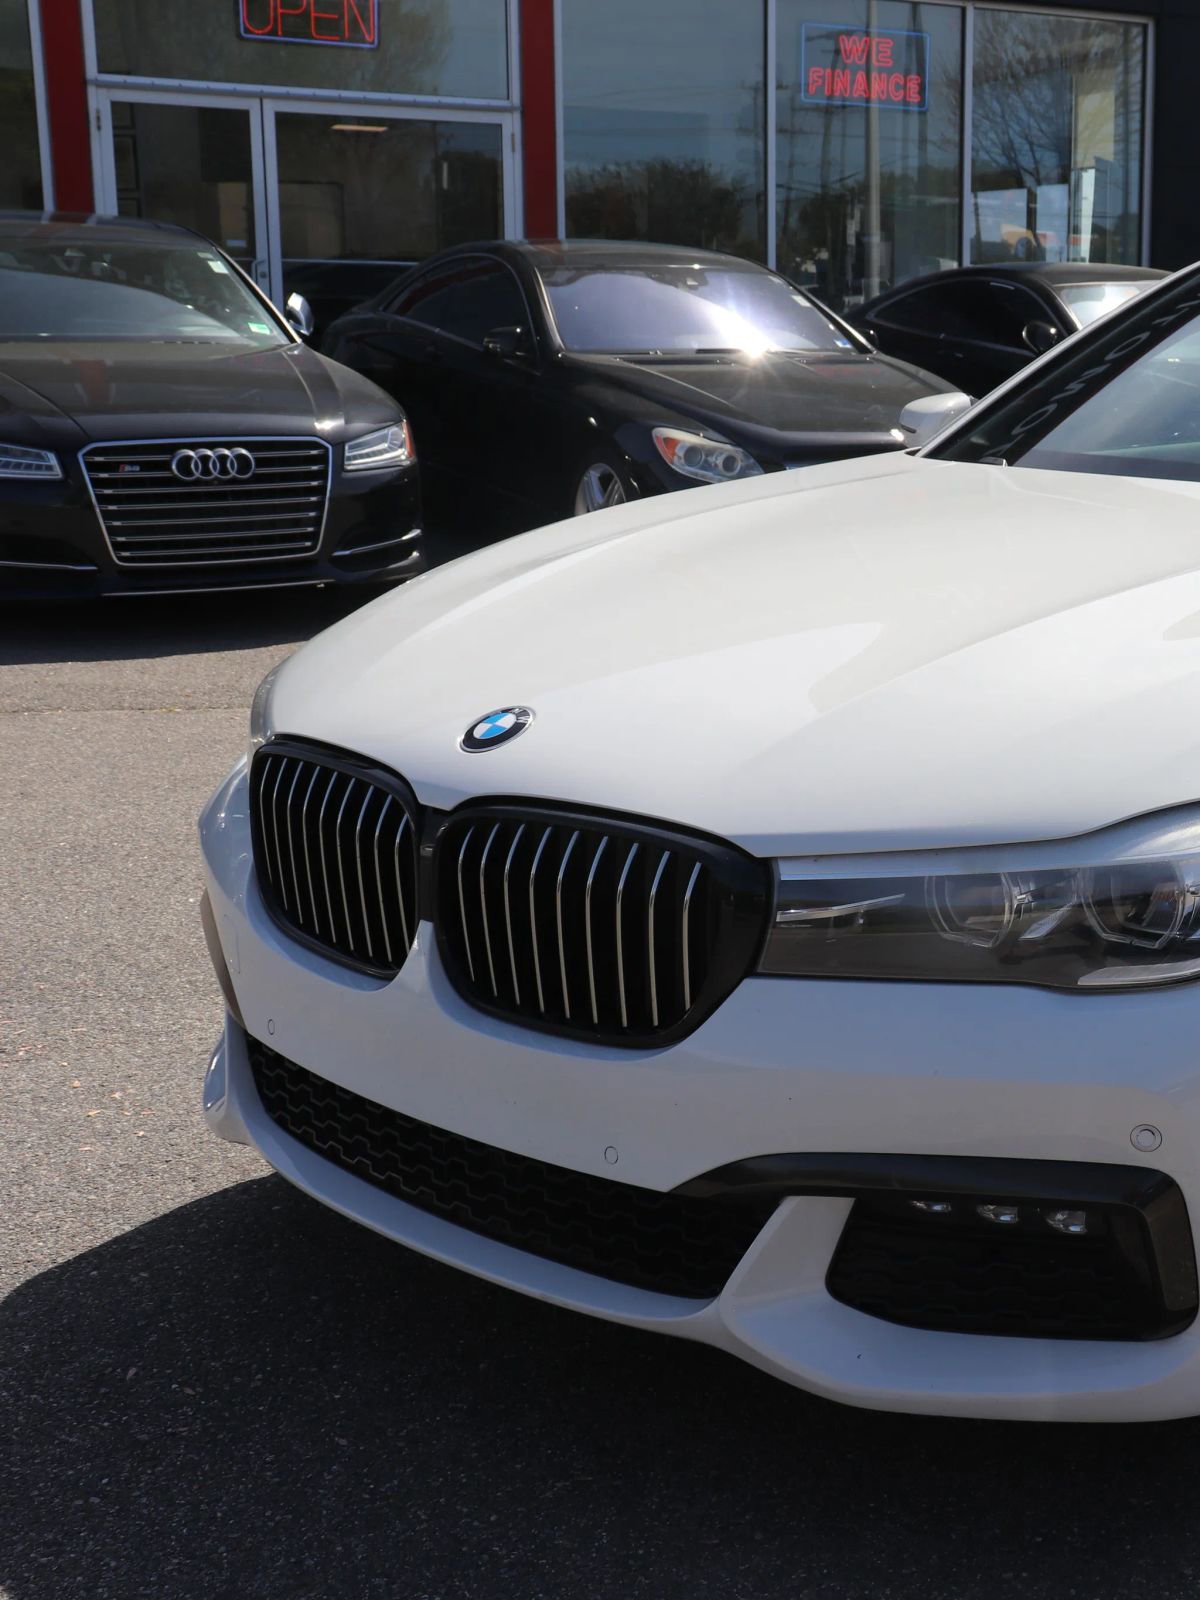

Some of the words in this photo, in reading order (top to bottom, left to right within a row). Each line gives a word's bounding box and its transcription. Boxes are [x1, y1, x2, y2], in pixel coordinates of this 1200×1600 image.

[243, 0, 375, 43] OPEN
[838, 34, 894, 67] WE
[807, 66, 922, 103] FINANCE
